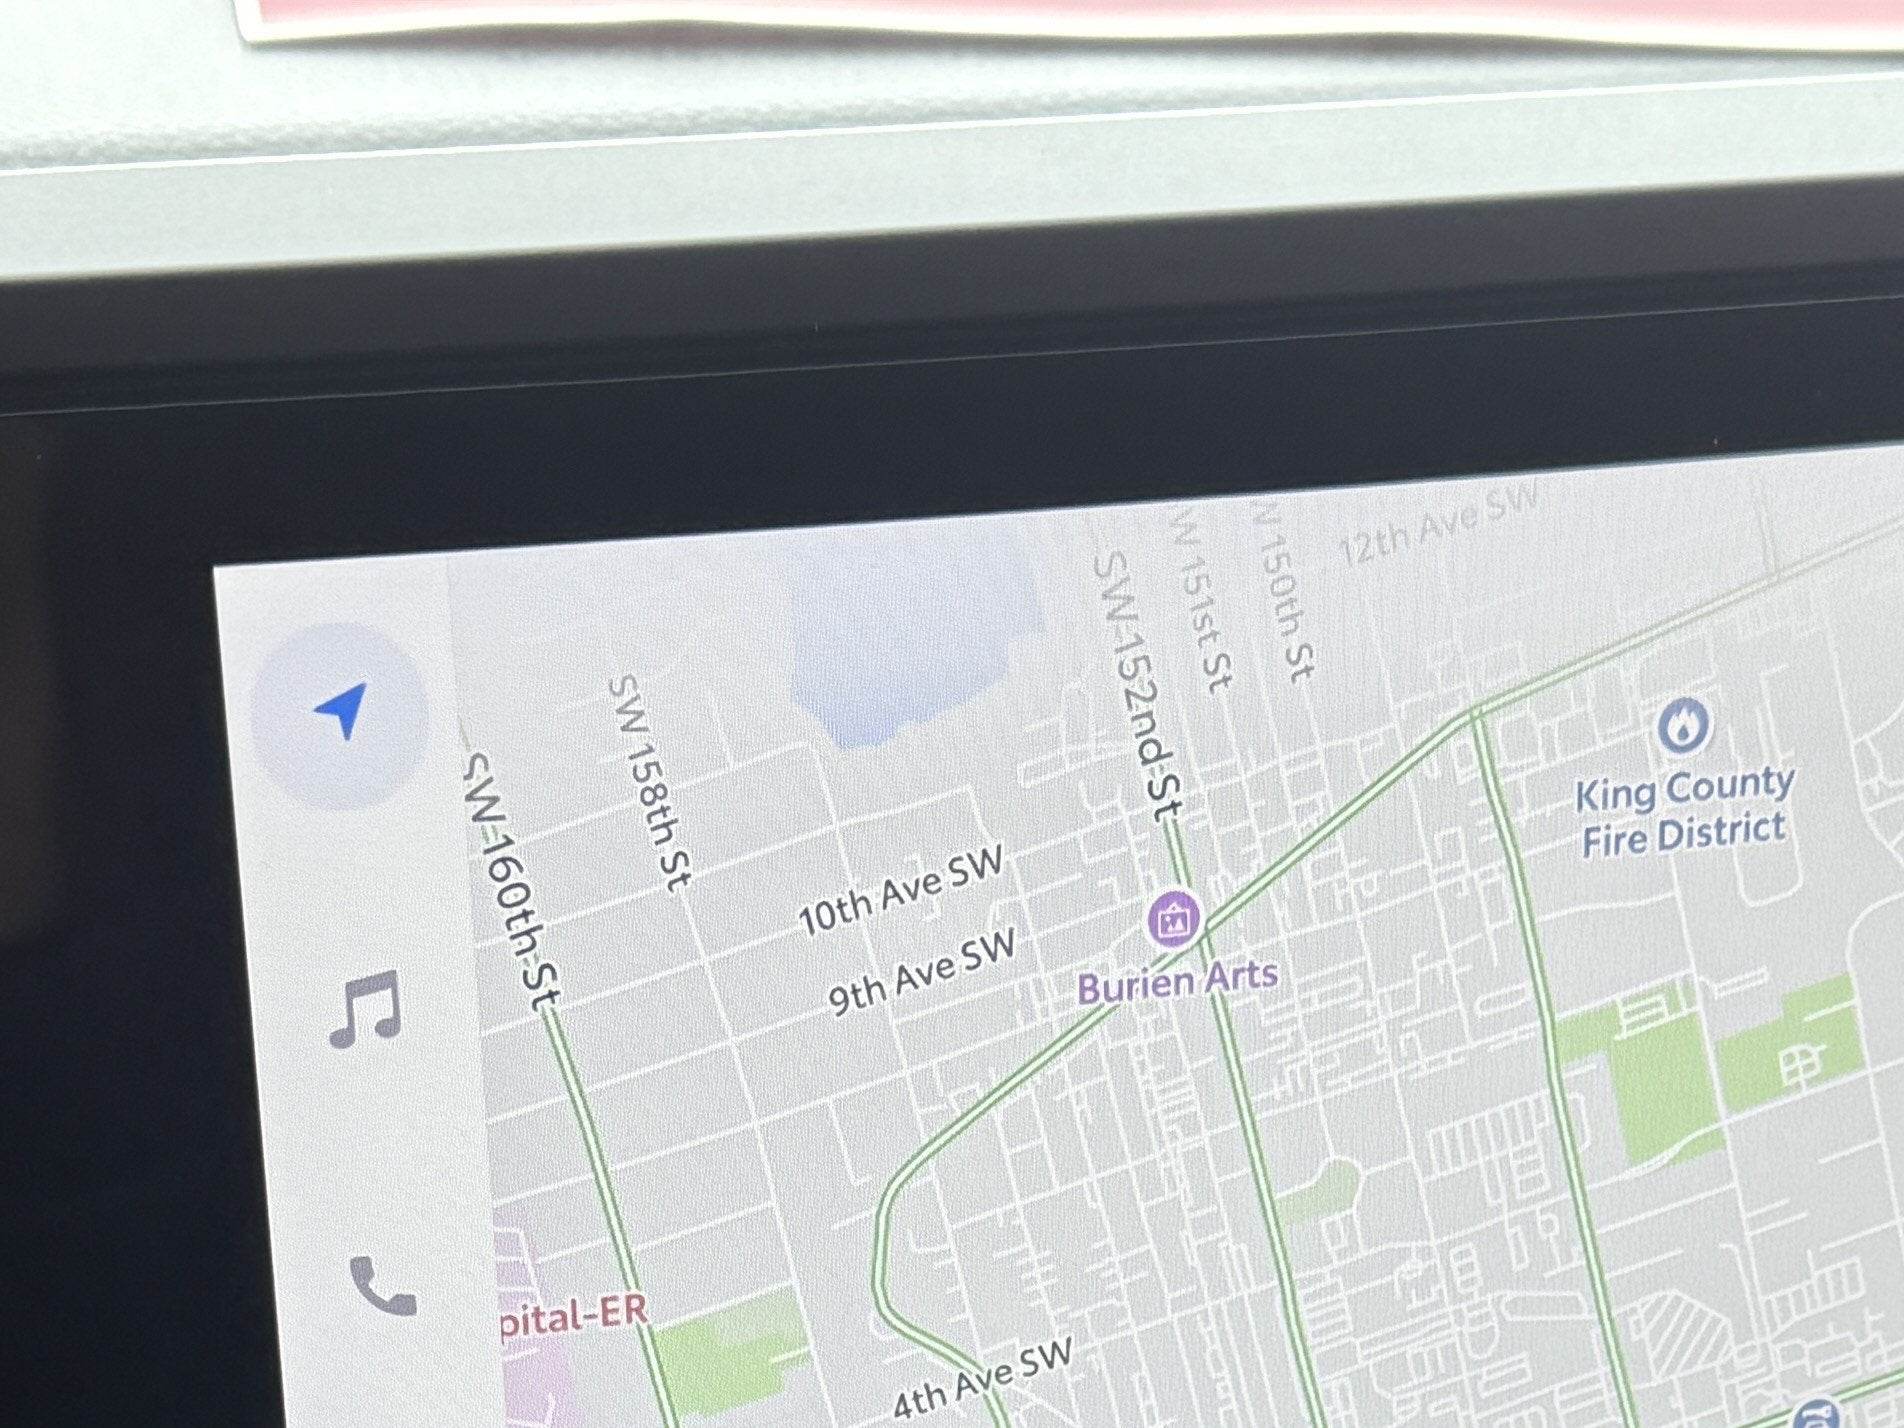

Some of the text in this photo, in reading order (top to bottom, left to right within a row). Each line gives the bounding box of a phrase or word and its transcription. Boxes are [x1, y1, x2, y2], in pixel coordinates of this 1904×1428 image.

[1340, 522, 1409, 567] 12th
[1420, 505, 1478, 545] Ave
[1182, 555, 1221, 649] 151st
[1203, 652, 1233, 695] St
[1261, 534, 1304, 637] 150th
[1285, 642, 1315, 684] St
[1094, 551, 1183, 823] SW 152nd St
[608, 673, 692, 893] SW 158th St
[1576, 765, 1796, 815] King County
[1583, 810, 1786, 859] Fire District
[463, 752, 561, 1013] SW 160th St
[799, 843, 1002, 937] 10th Ave SW
[829, 926, 1015, 1018] 9th Ave SW
[1078, 959, 1279, 1006] Burien Arts
[894, 1336, 1072, 1420] 4th Ave SW
